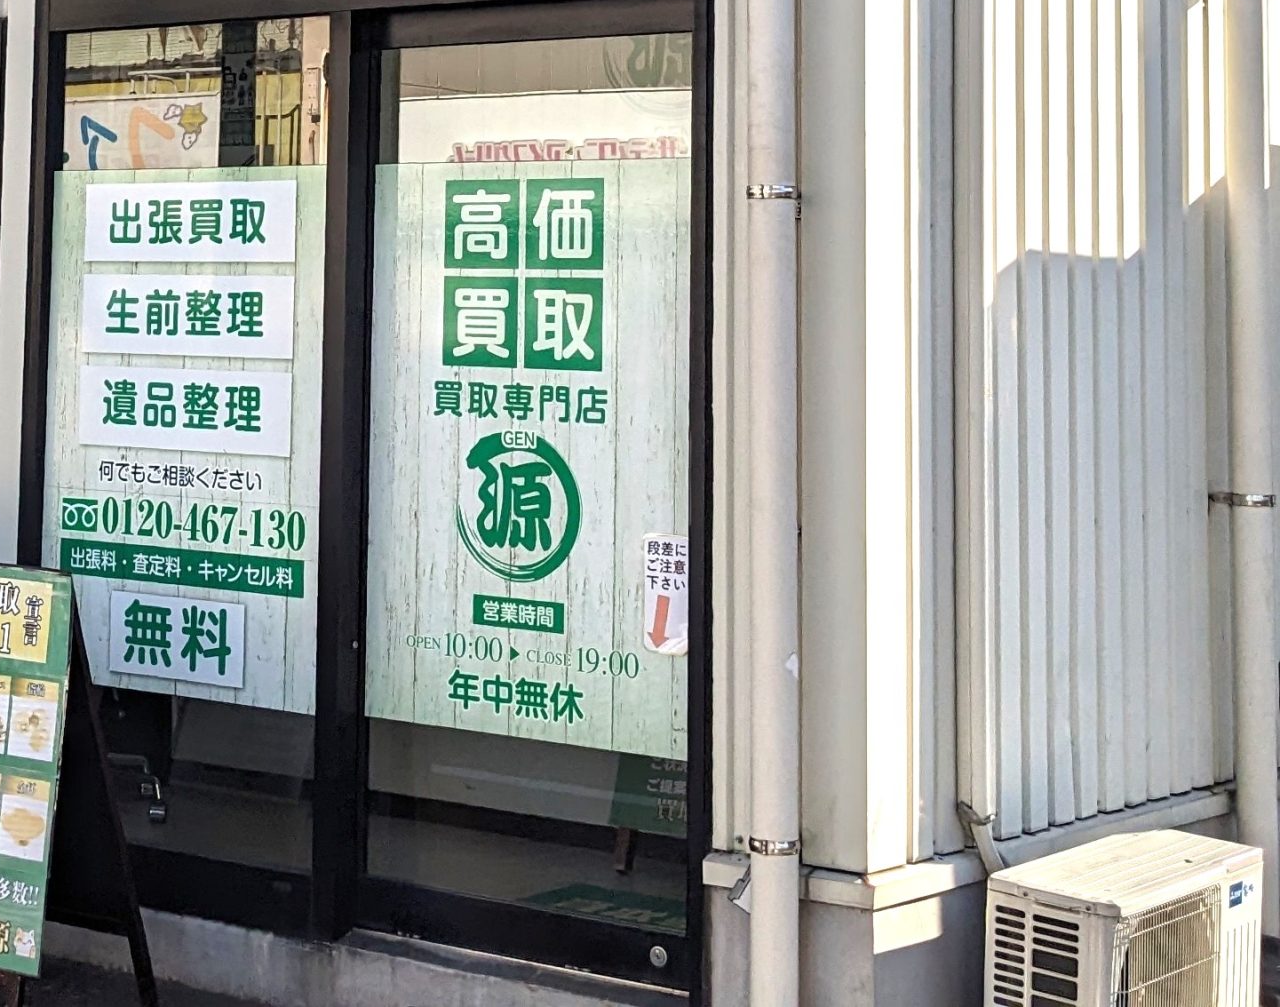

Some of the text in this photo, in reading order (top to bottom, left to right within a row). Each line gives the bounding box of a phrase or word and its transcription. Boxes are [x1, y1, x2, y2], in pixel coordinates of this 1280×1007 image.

[109, 198, 266, 245] 出張買取
[452, 189, 595, 261] 高価
[105, 288, 264, 338] 生前整理
[452, 288, 595, 361] 買取
[102, 378, 262, 433] 遺品整理
[434, 380, 608, 424] 買取専門店
[503, 430, 536, 447] GEN
[99, 460, 263, 491] 何でもご相談ください
[102, 496, 306, 552] 0120-467-130
[477, 461, 553, 552] 源
[70, 547, 294, 591] 出張料・査定料・キャンセル料
[647, 541, 687, 557] 段差に
[647, 558, 687, 575] ご注意
[646, 575, 687, 590] 下さい
[23, 595, 44, 647] 宣言
[123, 598, 232, 676] 無料
[482, 600, 554, 628] 営業時間
[406, 632, 639, 679] OPEN 10:00 CLOSE 19:00
[448, 669, 584, 724] 年中無休
